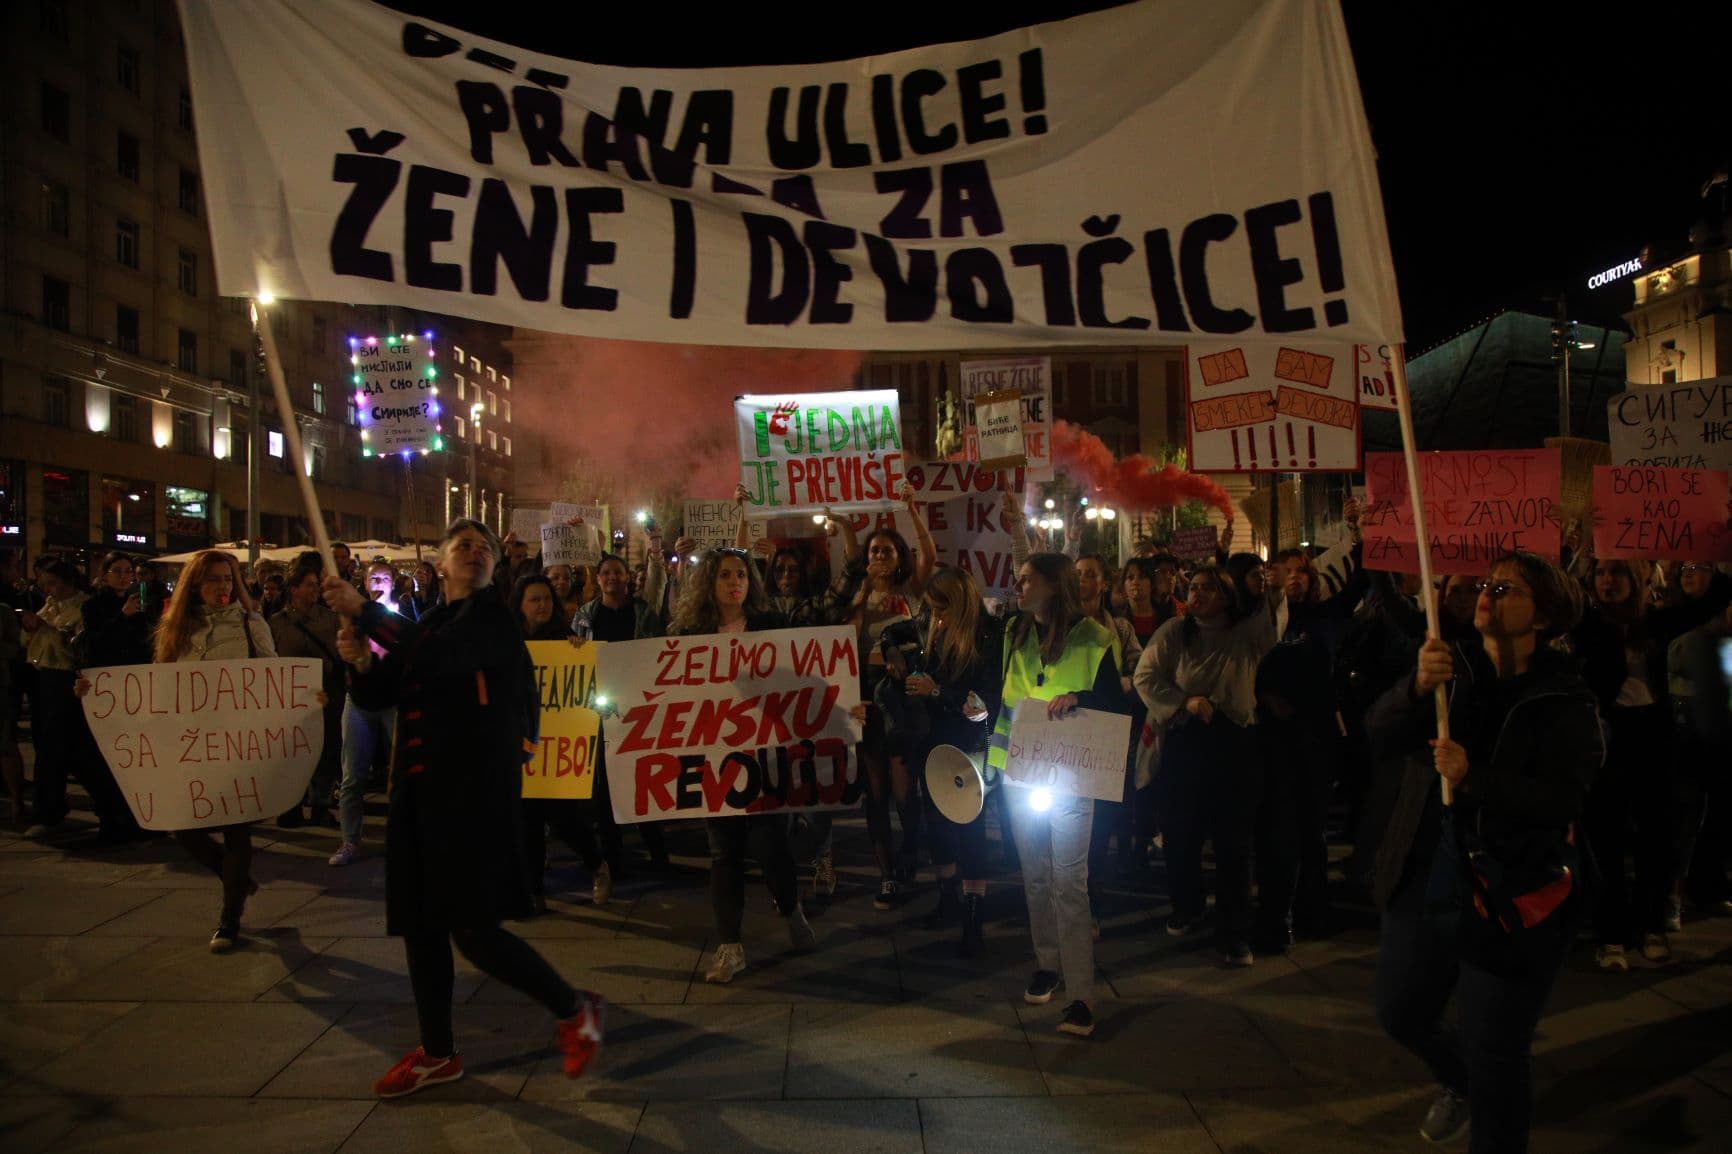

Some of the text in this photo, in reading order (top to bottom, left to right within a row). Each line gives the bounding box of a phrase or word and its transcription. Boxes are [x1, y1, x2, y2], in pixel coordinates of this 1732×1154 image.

[767, 48, 1047, 169] ULICE!
[874, 159, 1003, 238] ZA
[331, 128, 1348, 333] ŽENE I DEVOJČICE!
[391, 345, 410, 353] СТЕ
[364, 382, 384, 396] ДА
[418, 379, 431, 390] СЕ
[784, 405, 901, 454] JEDNA
[1643, 426, 1678, 450] ЗА
[742, 453, 903, 506] JE PREVIŠE
[1611, 468, 1702, 496] BORI SE
[689, 503, 741, 521] ЖЕНСК
[1366, 500, 1400, 527] ZA
[1464, 497, 1561, 529] ZATVOR
[1643, 499, 1680, 519] KAO
[1368, 530, 1526, 562] ZA ASILNIKE
[1616, 515, 1692, 552] ŽENA
[791, 638, 858, 678] VAM
[94, 665, 310, 719] SOLIDARNE
[615, 685, 840, 755] ŽENSKU
[114, 726, 312, 769] SA ŽENAMA
[135, 792, 153, 823] U
